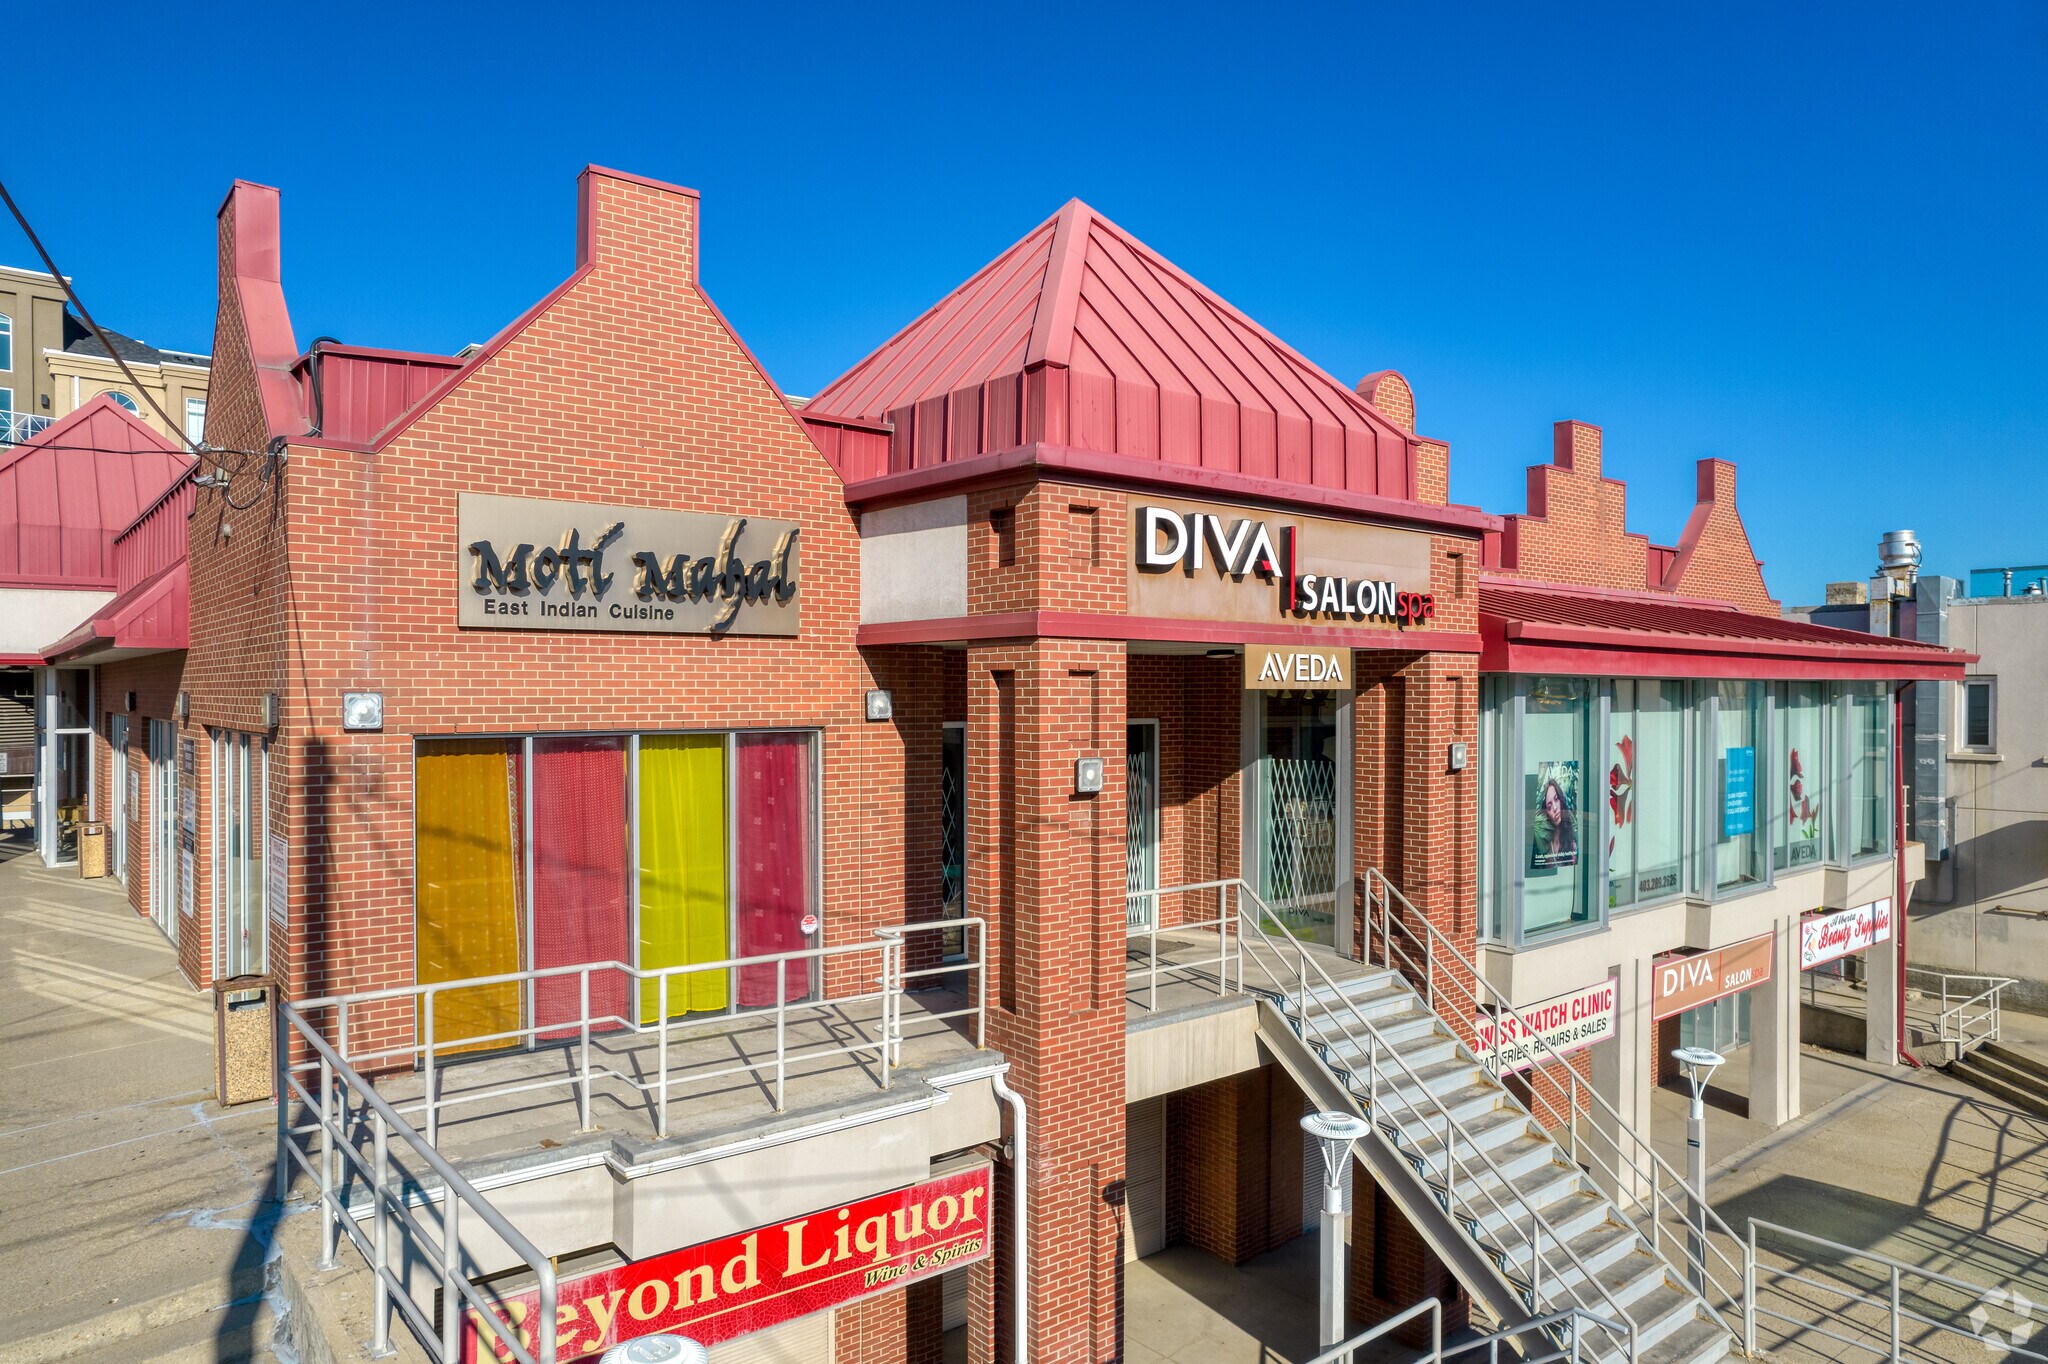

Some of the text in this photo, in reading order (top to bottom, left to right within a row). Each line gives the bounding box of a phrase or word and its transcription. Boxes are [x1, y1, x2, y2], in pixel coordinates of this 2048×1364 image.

[1138, 506, 1283, 580] DIVA
[468, 518, 800, 641] Moti Mahal
[484, 598, 675, 622] East Indian Cuisine
[1258, 651, 1343, 684] AVEDA
[1791, 844, 1817, 861] AVEDA
[1288, 906, 1310, 917] DIVA
[1818, 922, 1851, 950] Beauty
[1663, 958, 1713, 998] DIVA
[1521, 1003, 1567, 1038] WATCH
[1572, 988, 1612, 1022] CLINIC
[1572, 1027, 1579, 1041] &
[1581, 1017, 1607, 1038] SALES
[470, 1186, 985, 1364] Beyond Liquor
[864, 1238, 983, 1289] Wine & Spirits
